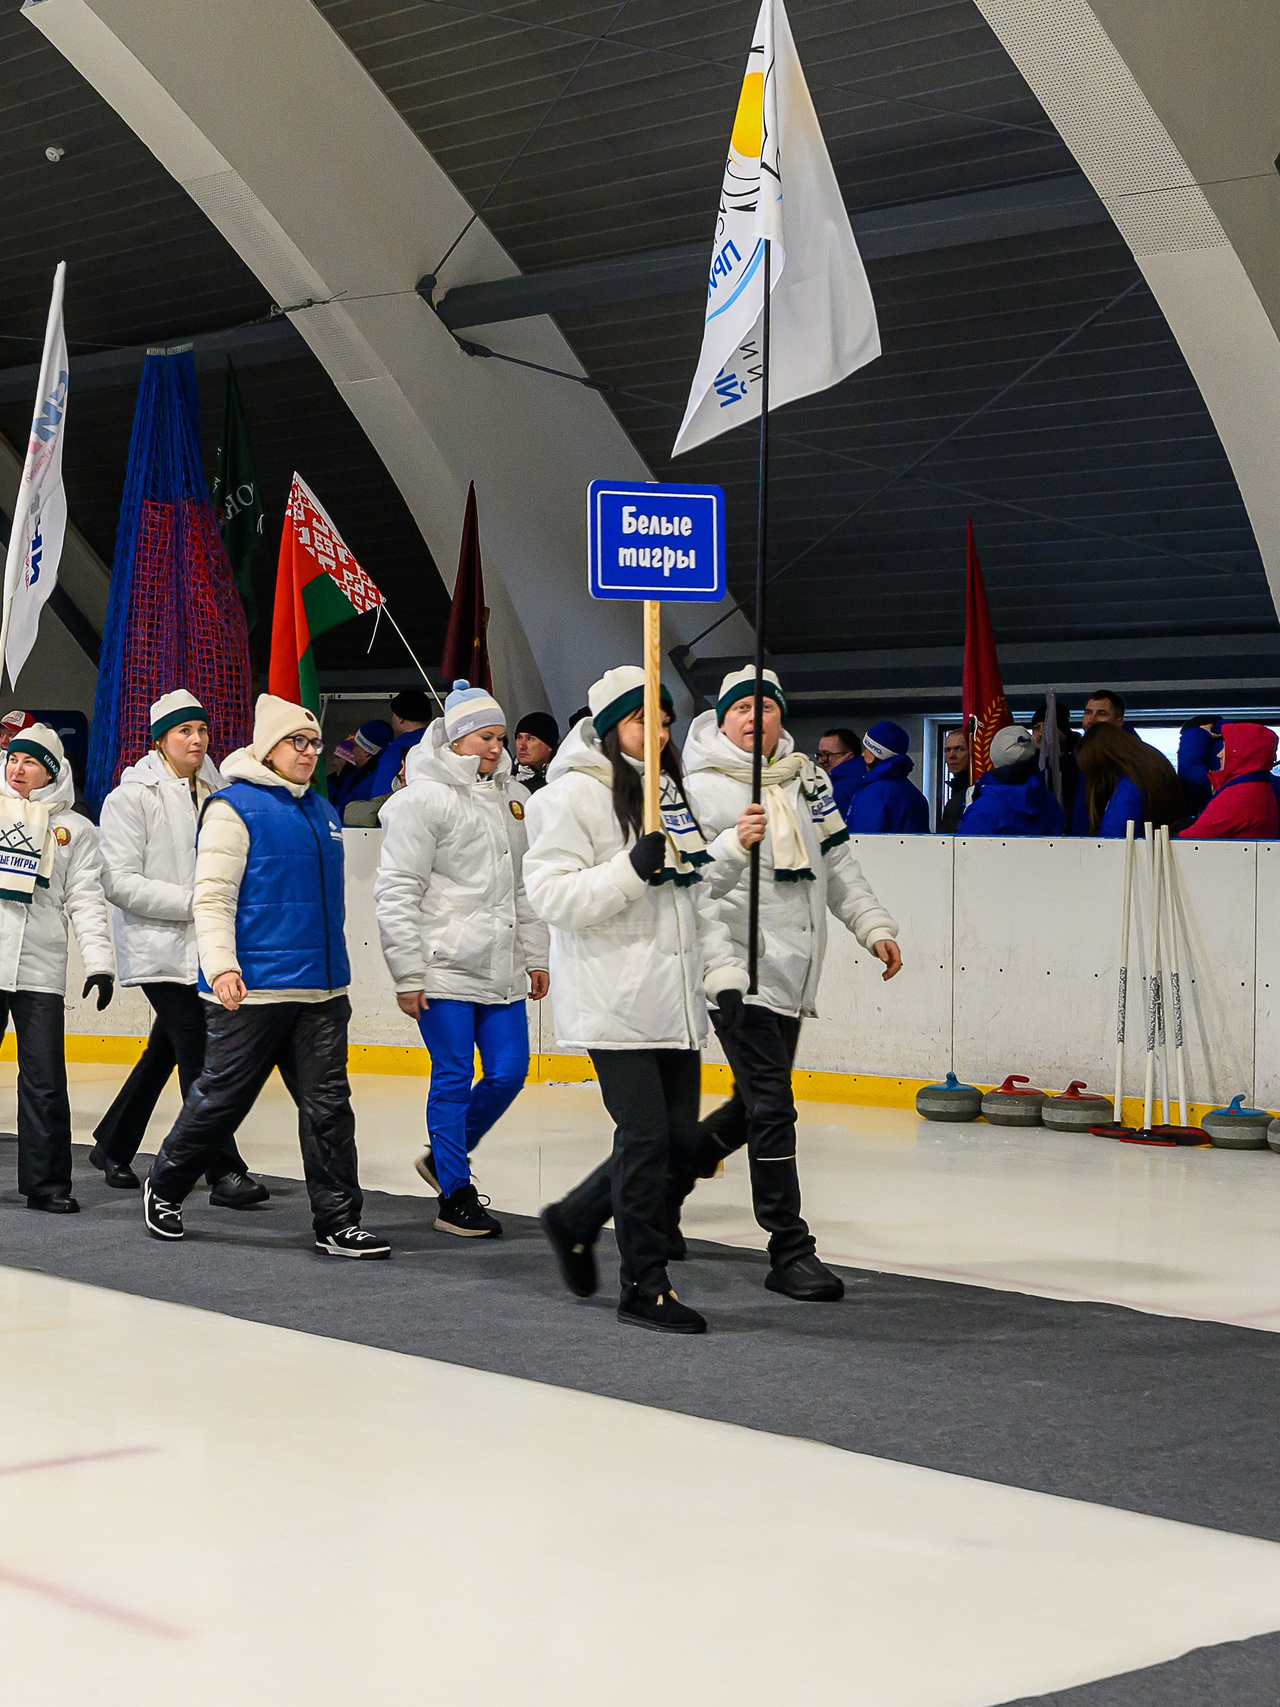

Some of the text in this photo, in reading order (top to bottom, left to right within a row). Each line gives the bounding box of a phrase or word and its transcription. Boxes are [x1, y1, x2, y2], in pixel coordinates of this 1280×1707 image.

[622, 505, 693, 537] Белые
[618, 546, 696, 577] тигры
[10, 856, 37, 870] ТИГРЫ
